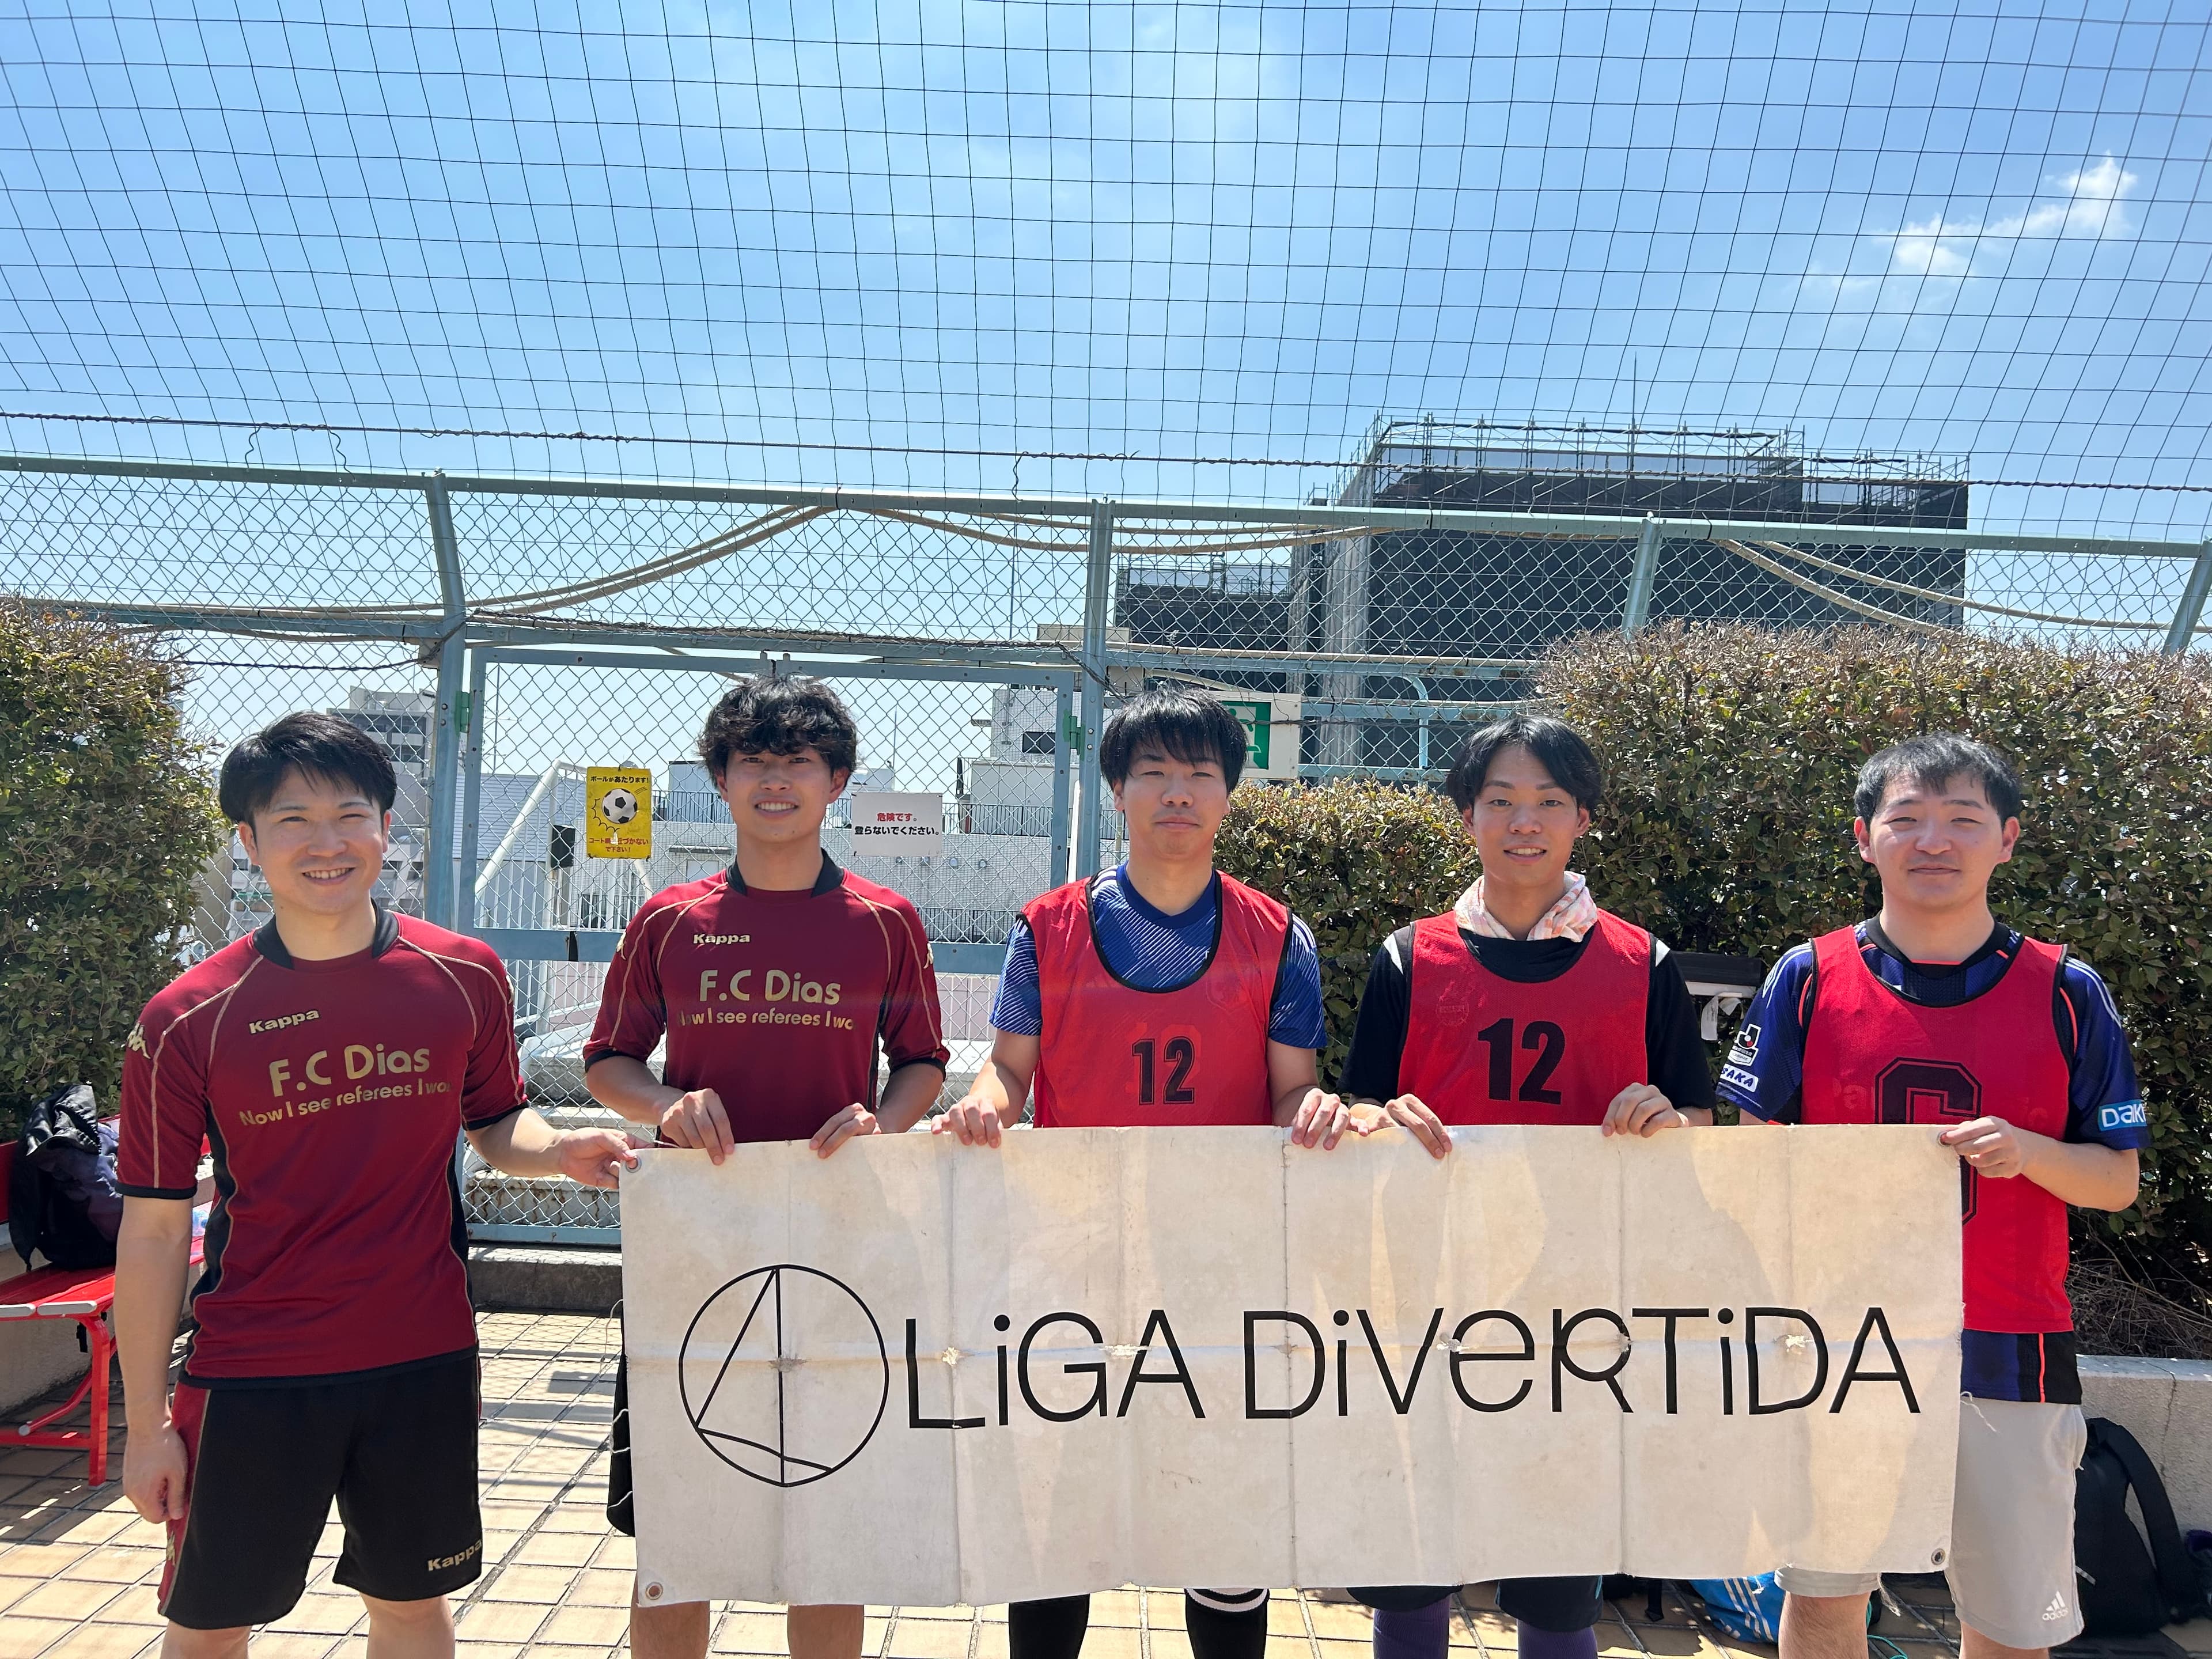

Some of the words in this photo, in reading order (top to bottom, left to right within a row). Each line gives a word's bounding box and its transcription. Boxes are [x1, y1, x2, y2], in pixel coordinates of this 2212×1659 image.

[854, 826, 940, 835] 登らないでください。
[877, 812, 917, 821] 危険です。
[693, 934, 750, 945] Kappa
[699, 969, 752, 1002] F.C
[764, 969, 841, 1005] Dias
[249, 1010, 319, 1034] Kappa
[707, 1007, 713, 1024] I
[716, 1012, 747, 1024] see
[752, 1007, 820, 1026] referees
[825, 1010, 831, 1027] I
[269, 1050, 332, 1097] F.C
[344, 1043, 430, 1080] Dias
[1131, 1036, 1196, 1105] 12
[1477, 1018, 1566, 1105] 12
[239, 1108, 283, 1126] Now
[286, 1101, 294, 1118] I
[298, 1097, 332, 1116] see
[336, 1085, 412, 1107] referees
[418, 1078, 423, 1096] I
[906, 1308, 1206, 1429] LiGA
[427, 1539, 482, 1571] Kappa
